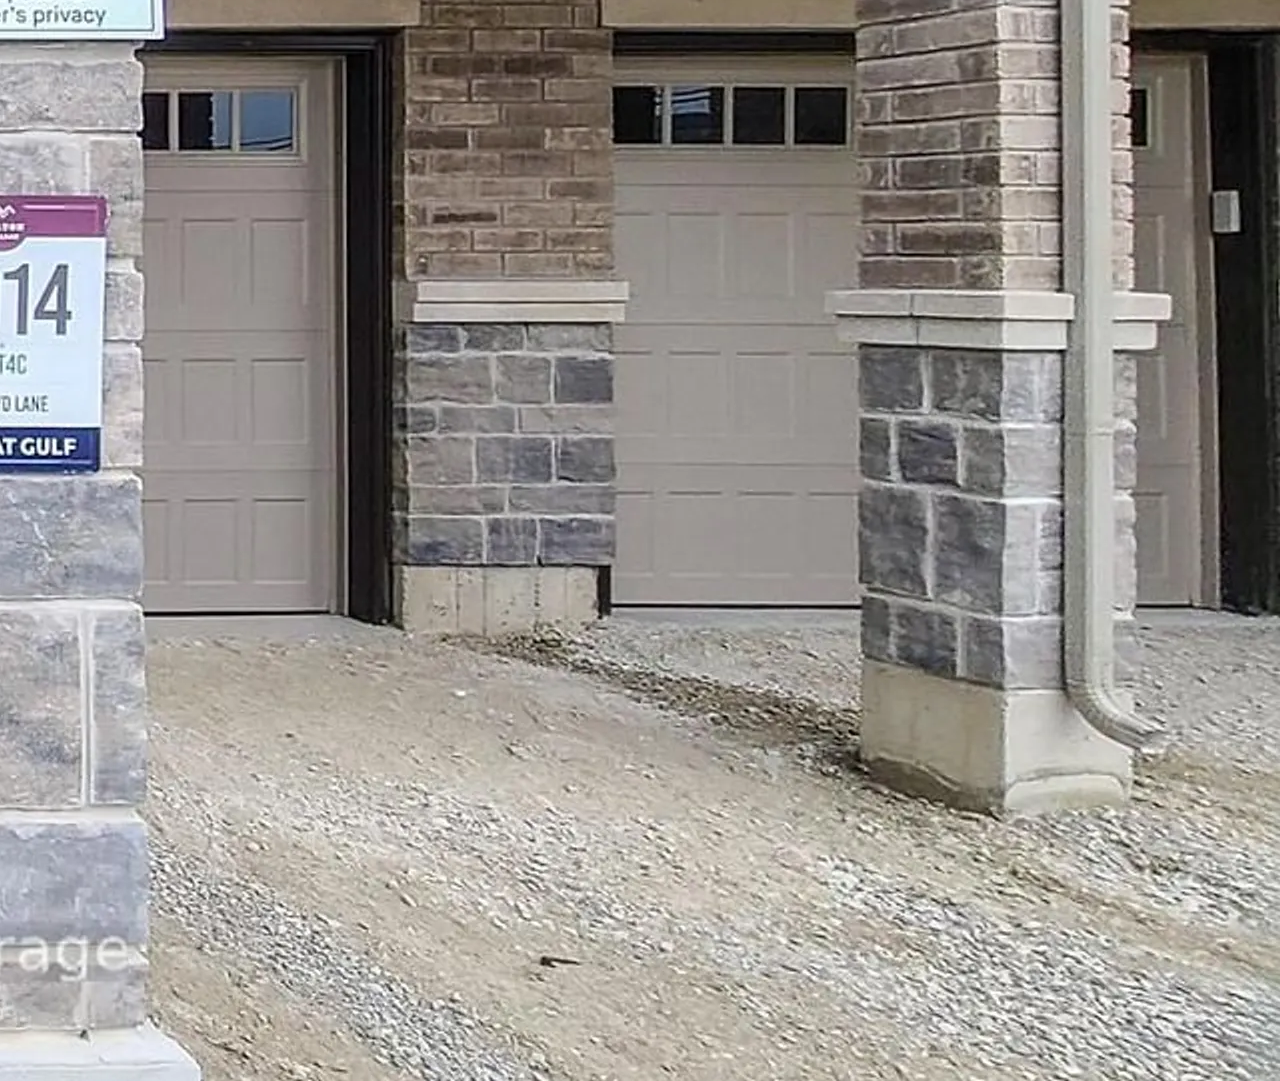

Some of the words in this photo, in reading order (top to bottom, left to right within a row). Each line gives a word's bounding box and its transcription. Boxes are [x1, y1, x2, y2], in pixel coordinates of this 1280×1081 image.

[33, 7, 106, 27] privacy
[14, 395, 49, 413] LANE
[20, 437, 77, 456] GULF
